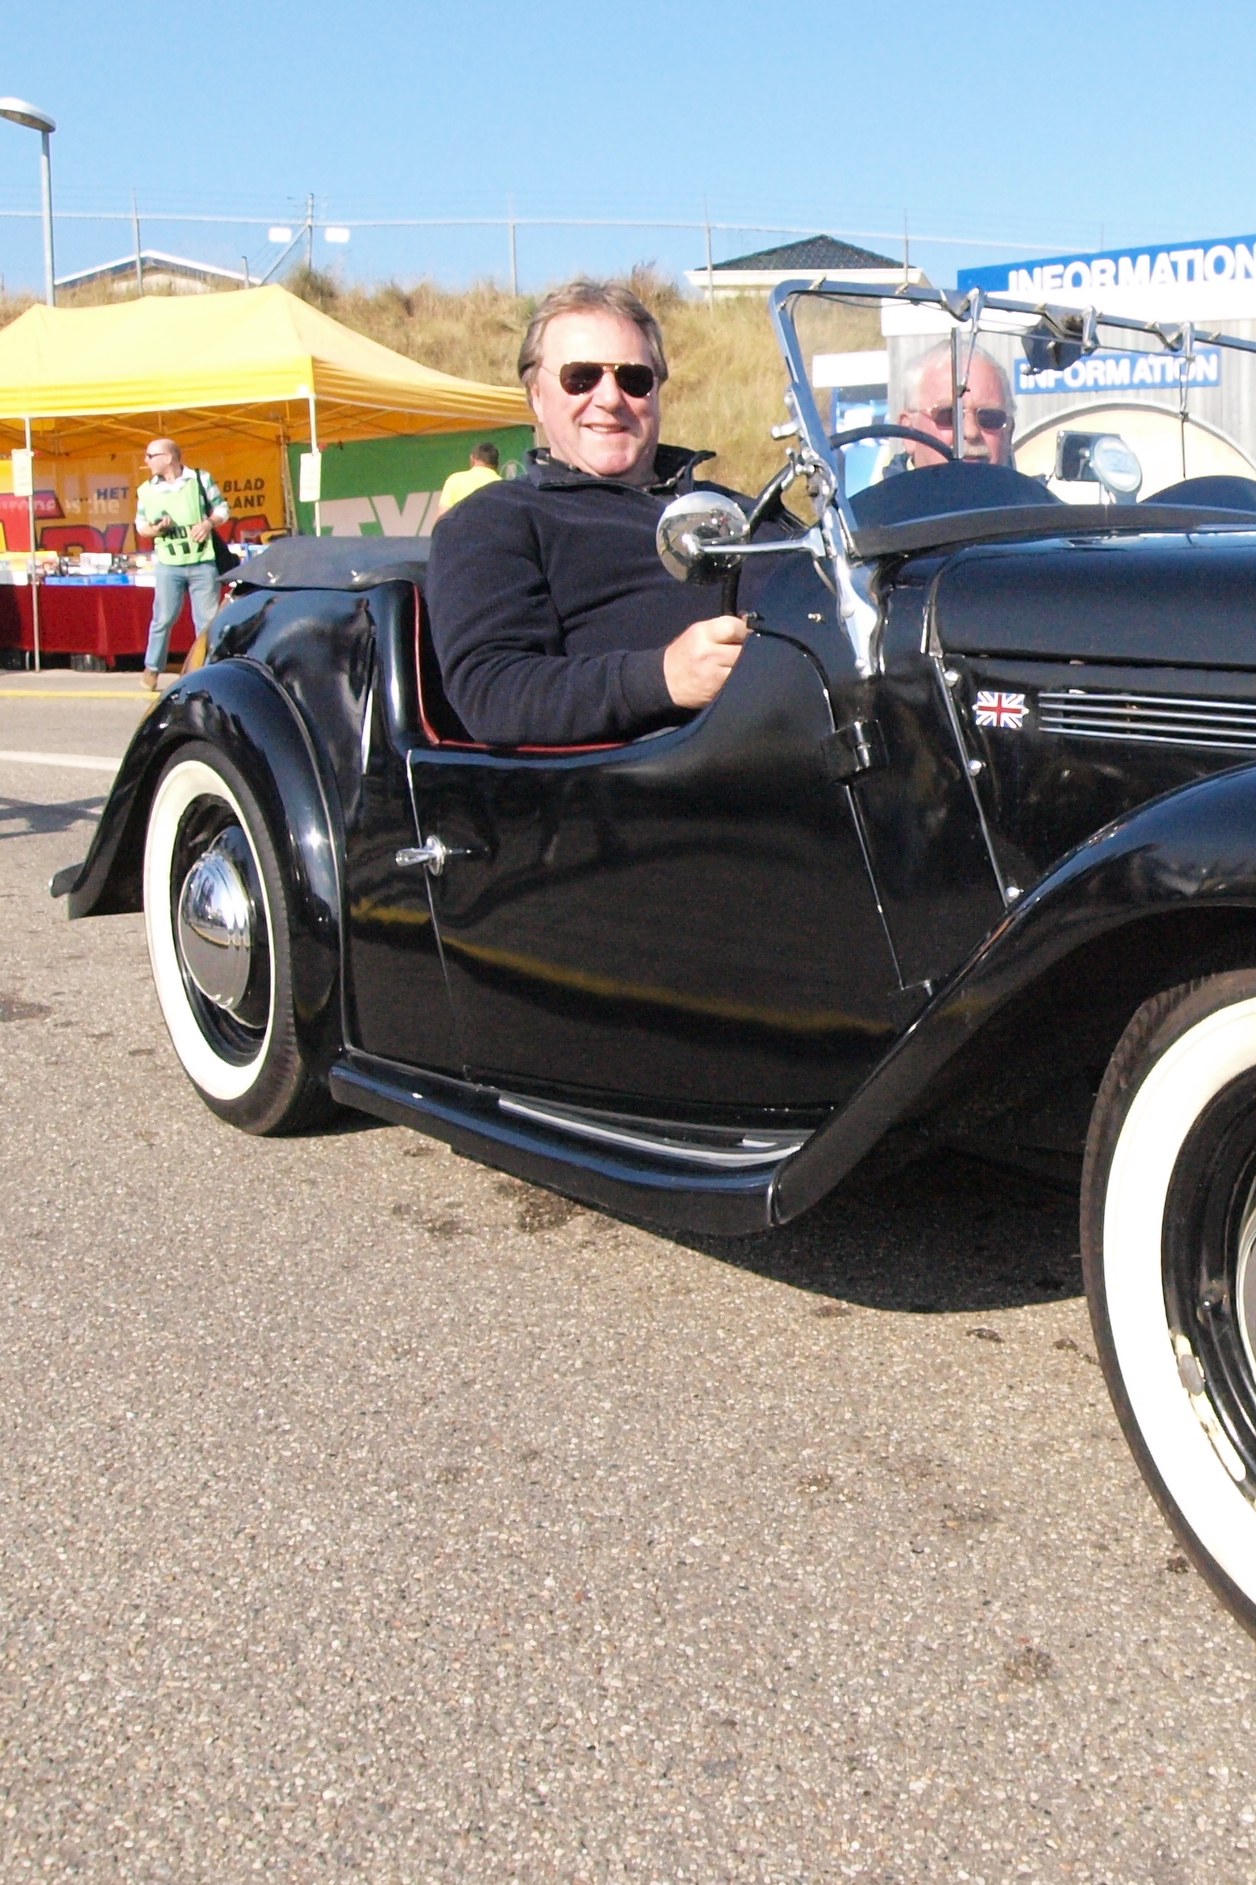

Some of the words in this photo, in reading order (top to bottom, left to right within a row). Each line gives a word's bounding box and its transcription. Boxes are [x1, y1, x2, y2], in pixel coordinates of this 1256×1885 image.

[1019, 353, 1218, 389] INFORMATION
[97, 487, 129, 500] HET
[223, 478, 265, 493] BLAD
